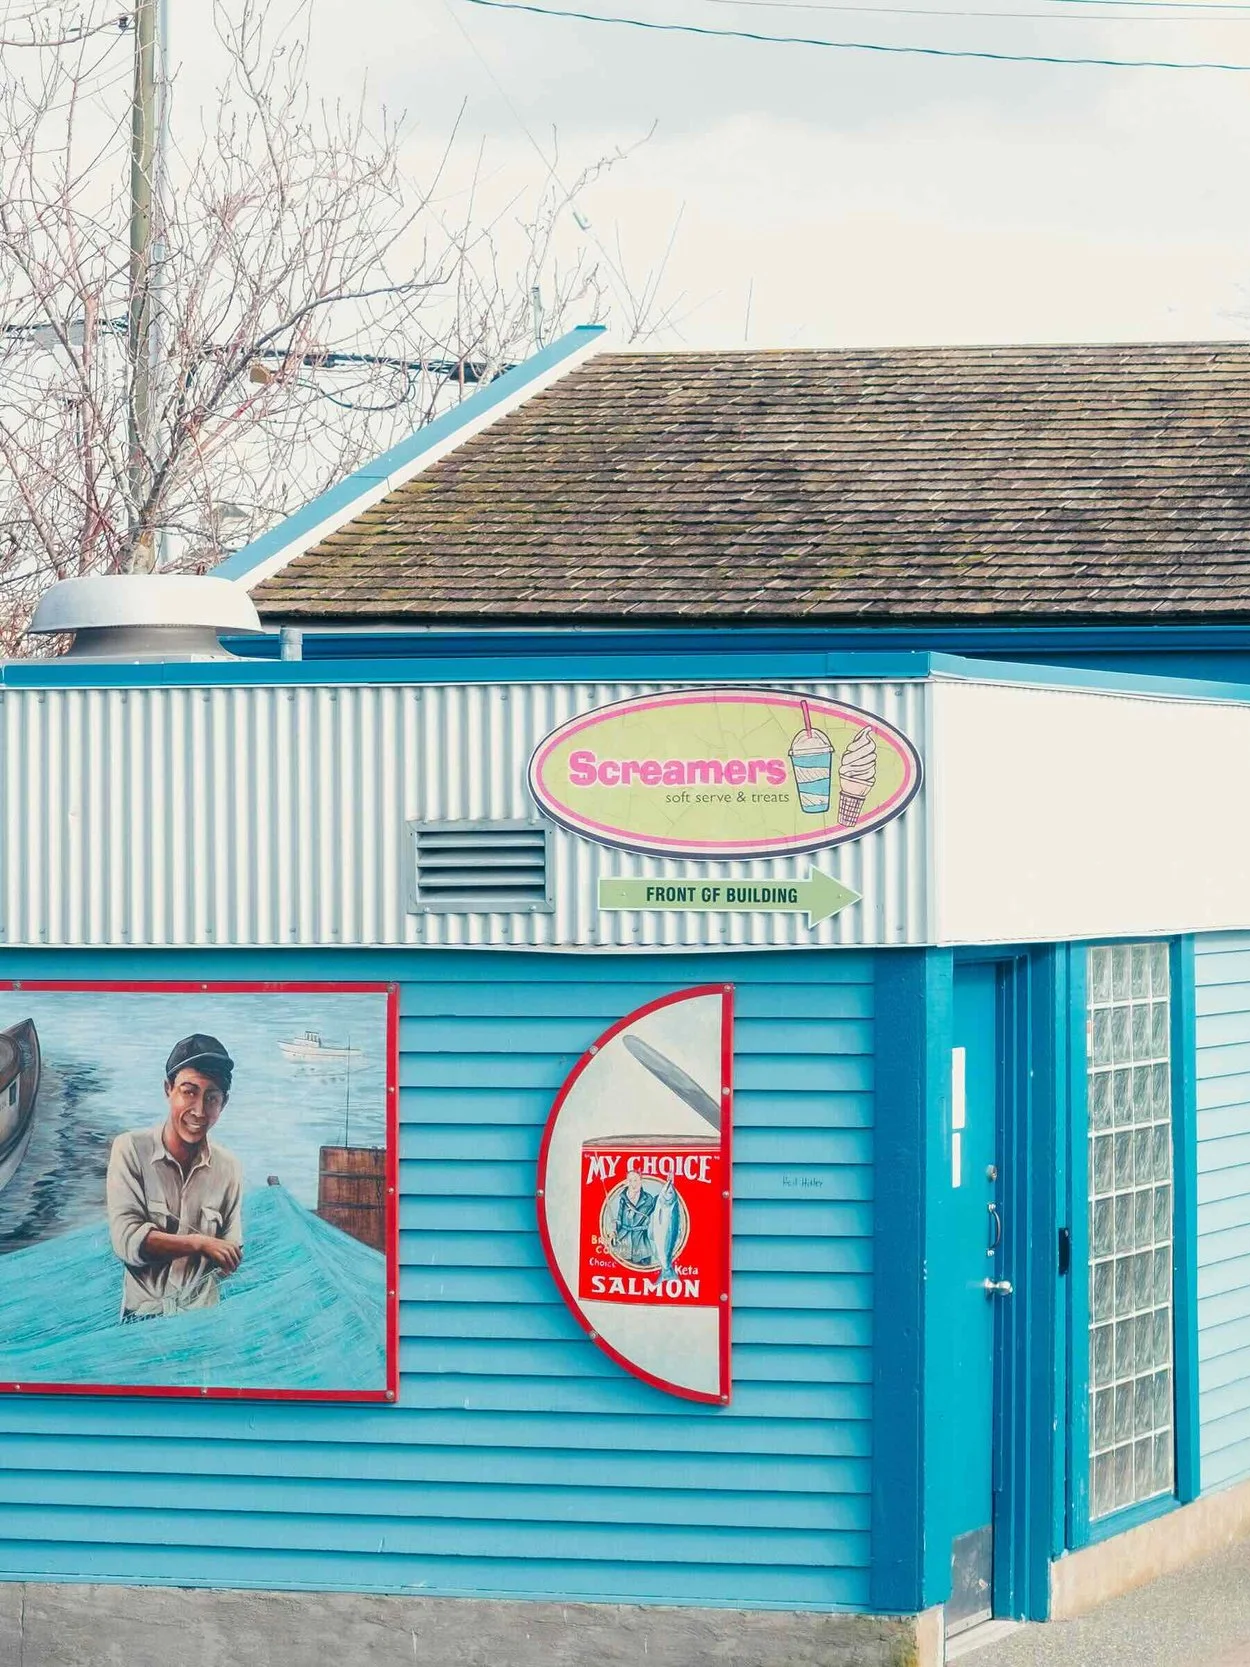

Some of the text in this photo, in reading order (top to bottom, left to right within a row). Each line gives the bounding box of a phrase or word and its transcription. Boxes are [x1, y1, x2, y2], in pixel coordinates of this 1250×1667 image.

[568, 750, 788, 787] Screamers
[665, 791, 790, 803] soft serve & treats
[646, 886, 696, 902] FRONT
[726, 887, 798, 904] BUILDING
[674, 1264, 700, 1276] Keta
[591, 1275, 701, 1298] SALMON
